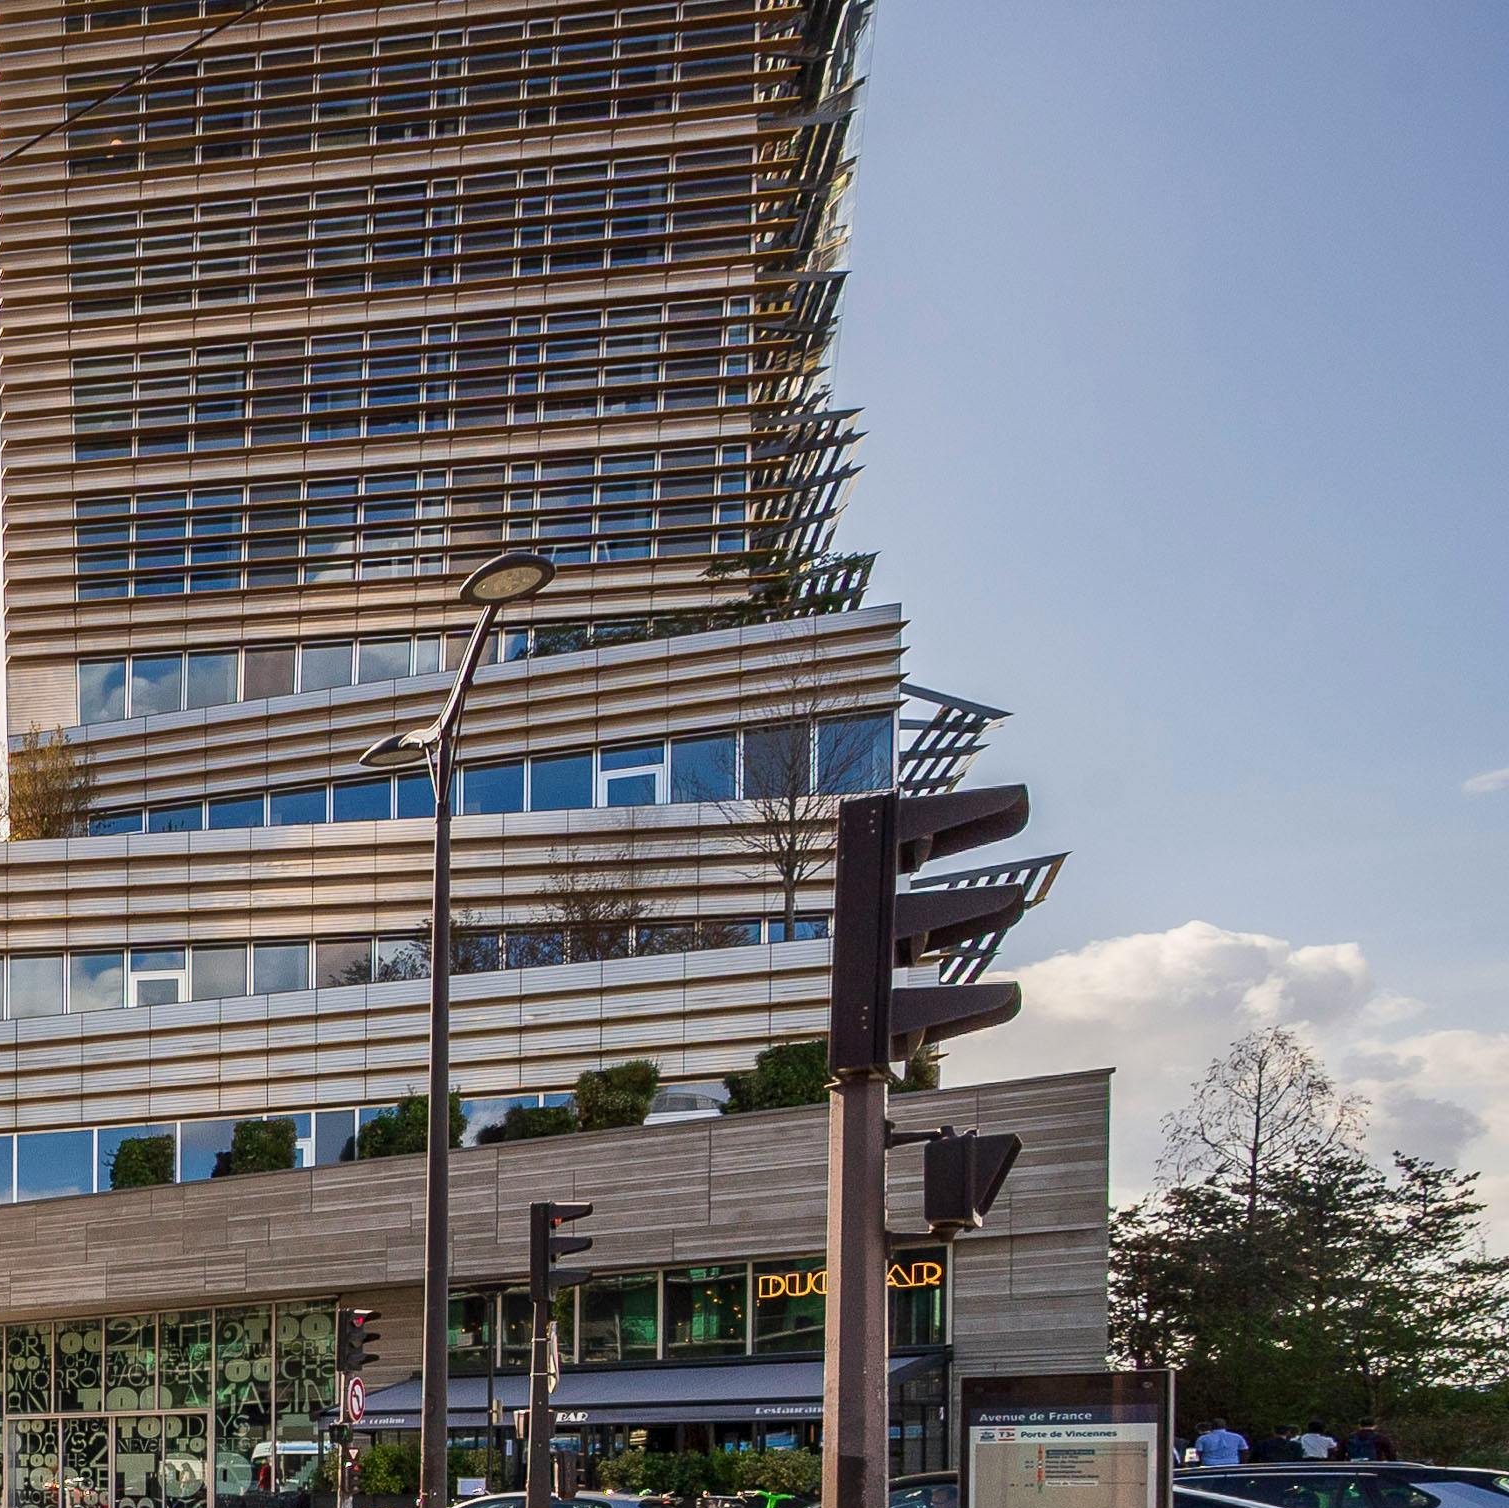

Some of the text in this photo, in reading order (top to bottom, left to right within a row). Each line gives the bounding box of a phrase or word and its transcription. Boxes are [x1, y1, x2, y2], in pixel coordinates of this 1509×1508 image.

[979, 1412, 1092, 1422] Avenue de France
[1065, 1430, 1118, 1438] Vincennes
